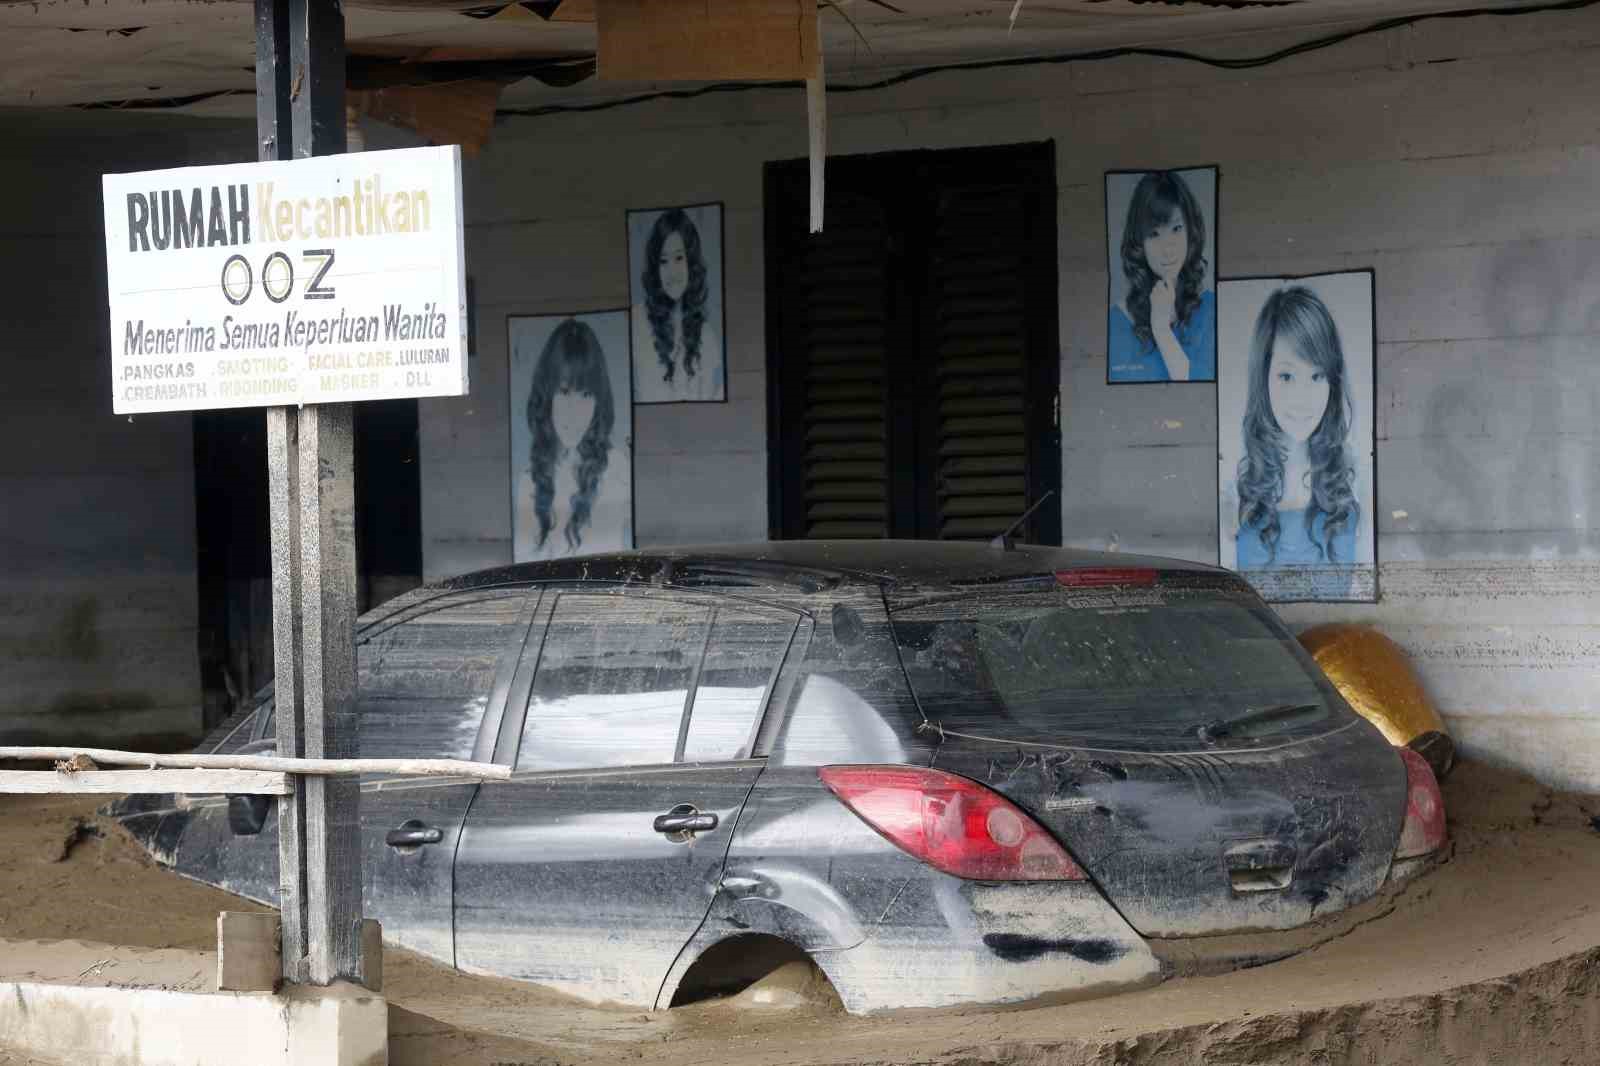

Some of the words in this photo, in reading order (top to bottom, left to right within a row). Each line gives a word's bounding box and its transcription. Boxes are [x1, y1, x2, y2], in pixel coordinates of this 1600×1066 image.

[126, 184, 251, 252] RUMAH
[256, 174, 430, 243] Kecantikan
[123, 318, 216, 356] Menerima
[220, 315, 280, 350] Semua
[284, 307, 379, 354] Keperluan
[383, 303, 447, 343] Wanita
